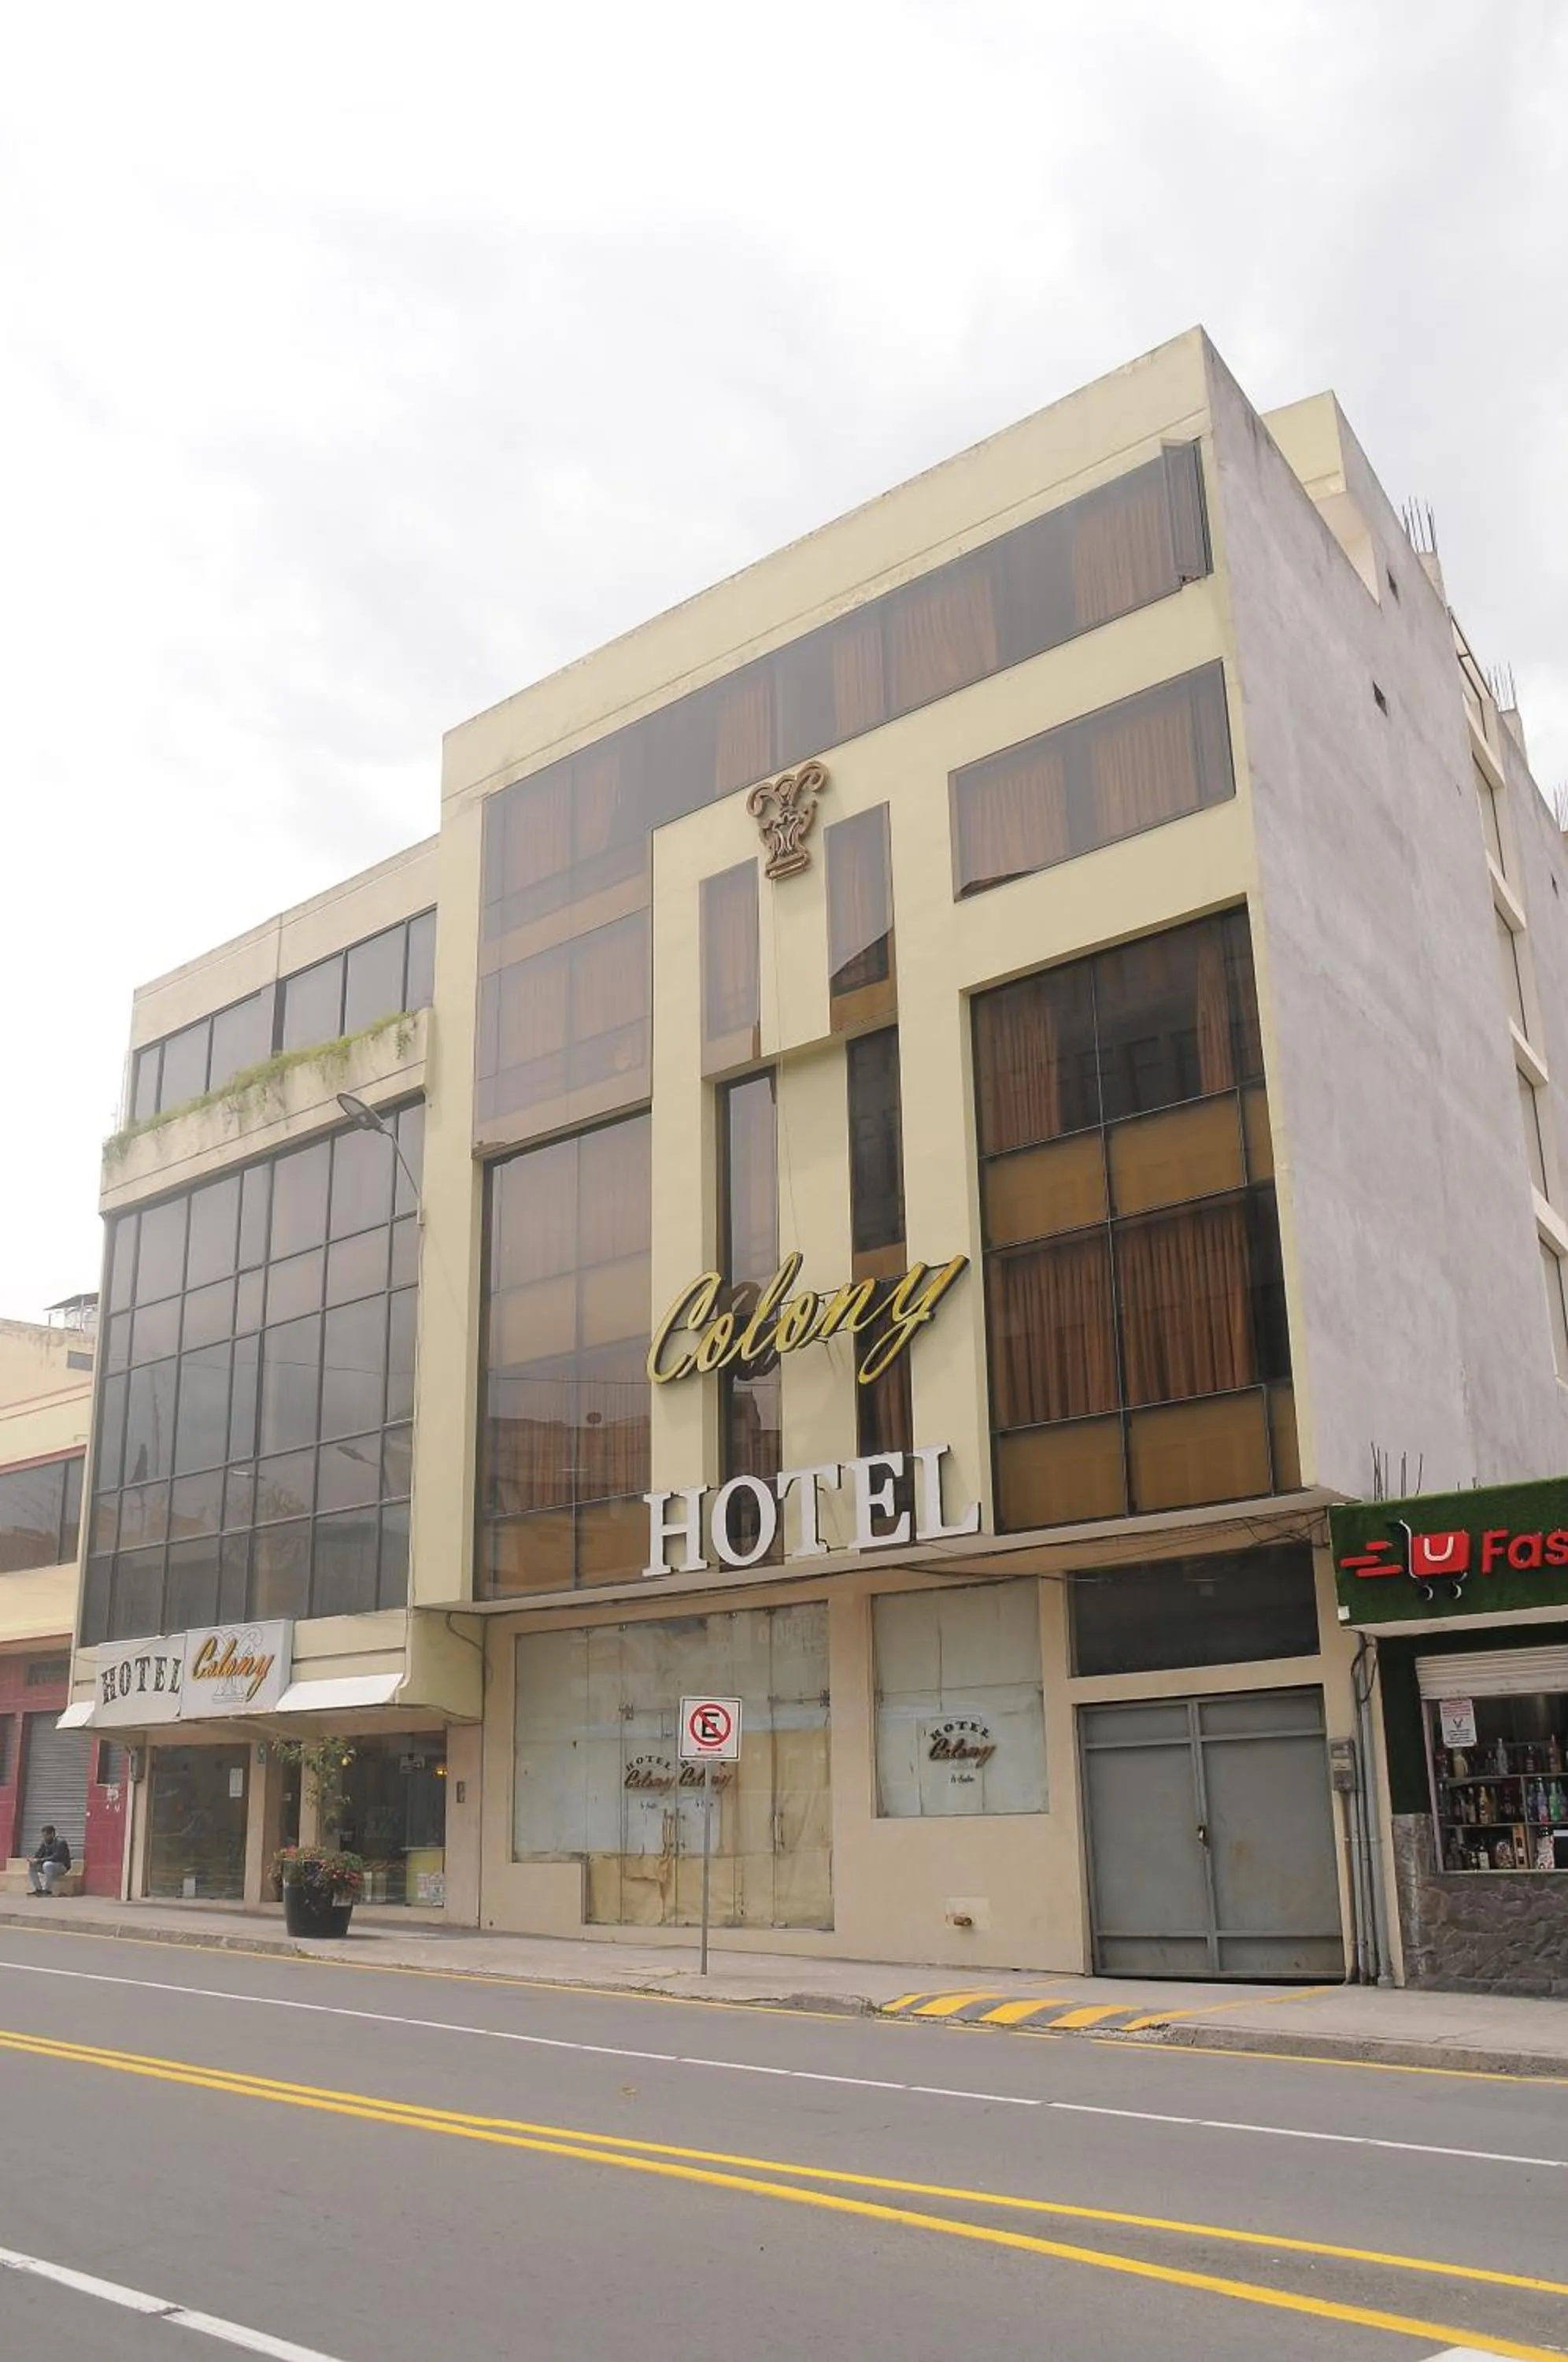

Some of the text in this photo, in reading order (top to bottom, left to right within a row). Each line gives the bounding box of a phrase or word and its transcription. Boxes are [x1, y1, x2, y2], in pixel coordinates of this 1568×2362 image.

[646, 1251, 970, 1384] Colony
[642, 1444, 982, 1576] HOTEL
[101, 1635, 275, 1705] HOTEL Colony
[702, 1712, 720, 1738] E
[930, 1720, 989, 1741] HOTEL
[626, 1754, 671, 1772] HOTEL
[929, 1737, 997, 1769] Colony
[679, 1767, 733, 1794] Colny
